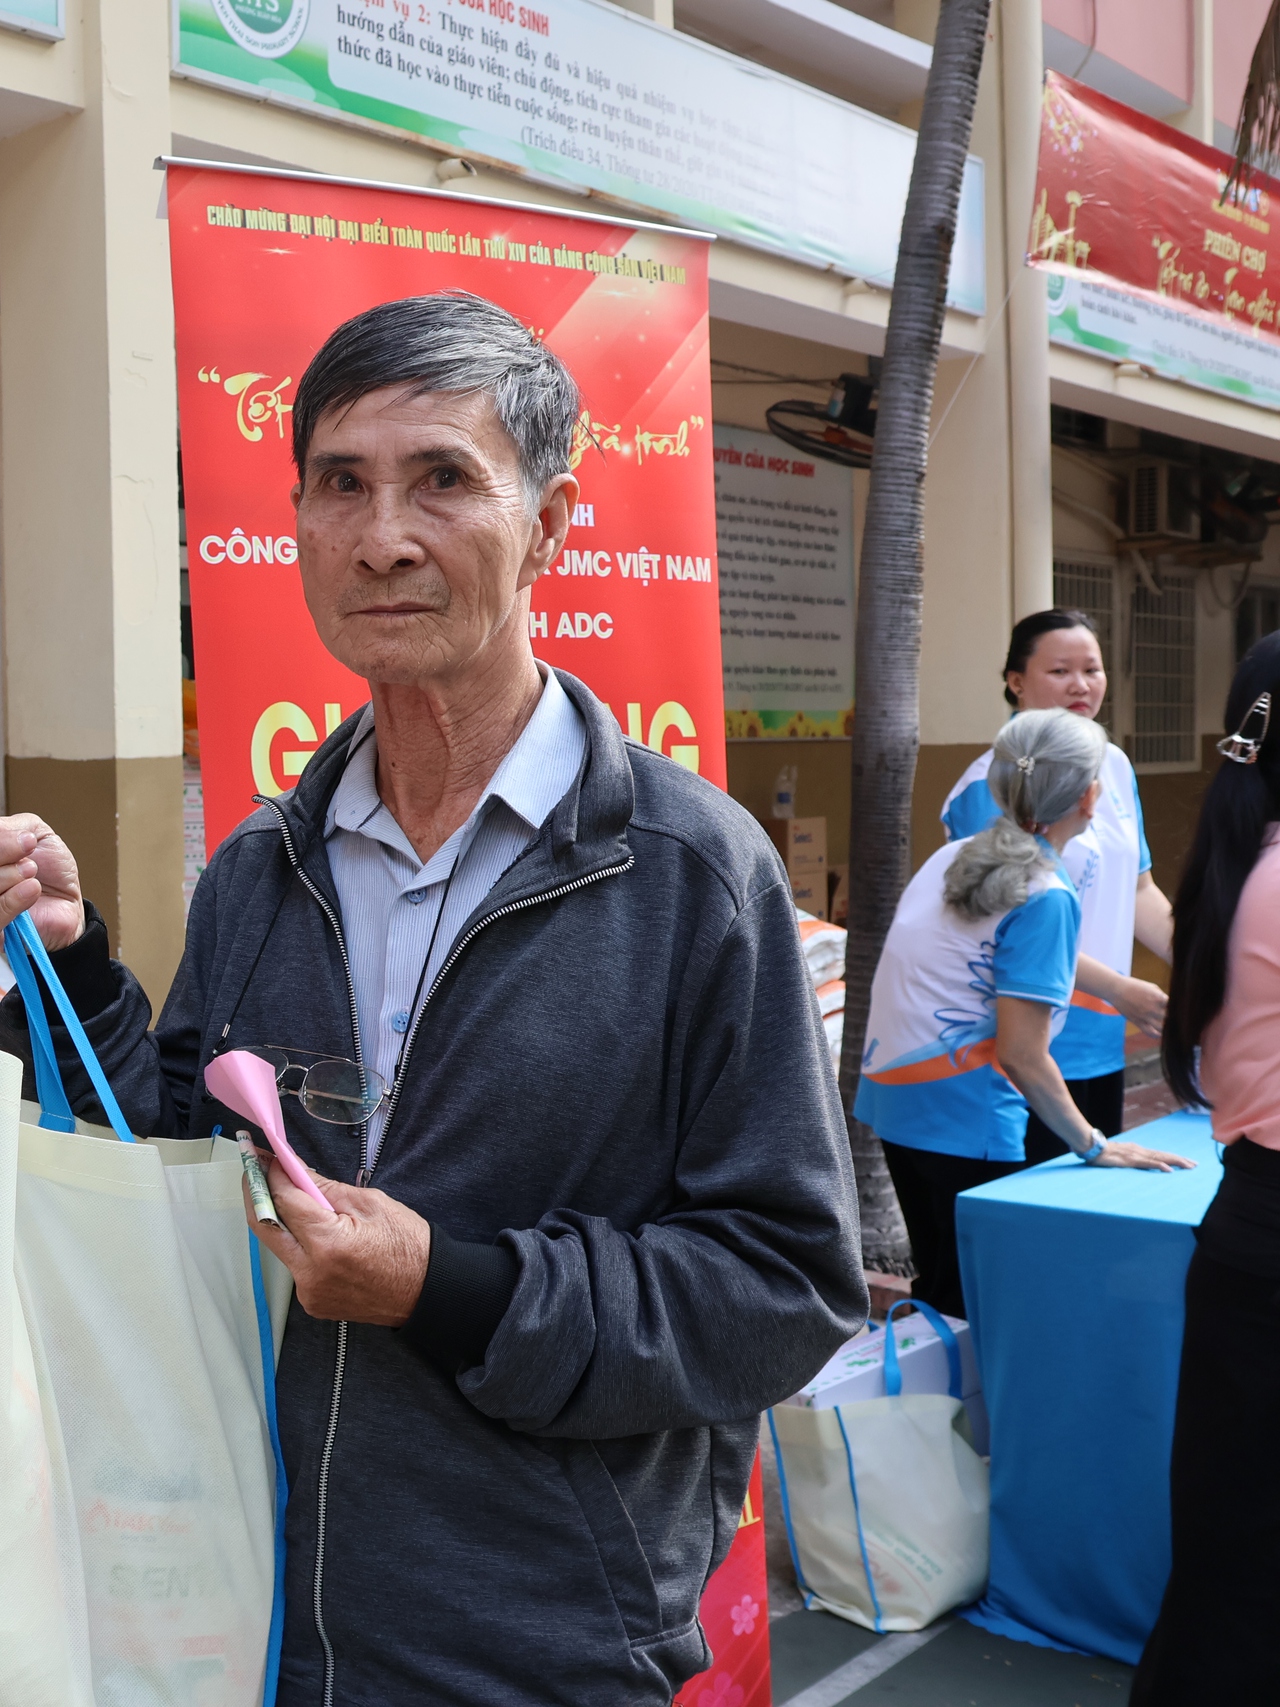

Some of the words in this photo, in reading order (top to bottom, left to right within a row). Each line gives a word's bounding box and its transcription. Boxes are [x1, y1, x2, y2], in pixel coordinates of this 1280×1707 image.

[337, 4, 384, 42] hướng
[389, 20, 415, 48] dẫn
[420, 34, 443, 59] của
[448, 44, 474, 69] giáo
[479, 56, 510, 82] viên;
[439, 11, 474, 41] Thực
[481, 27, 508, 53] hiện
[515, 39, 538, 69] đầy
[545, 51, 560, 71] đủ
[520, 6, 549, 37] SINH
[337, 34, 370, 62] thức
[375, 45, 393, 68] đã
[398, 56, 422, 79] học
[425, 66, 449, 88] vào
[454, 72, 484, 99] thực
[521, 123, 557, 156] (Trích
[206, 203, 242, 228] CHÀO
[245, 207, 287, 232] MỪNG
[290, 213, 311, 239] ĐẠI
[314, 215, 336, 242] HỘI
[339, 220, 359, 245] ĐẠI
[362, 218, 389, 245] BIỂU
[392, 225, 423, 249] TOÀN
[426, 229, 456, 253] QUỐC
[459, 232, 481, 257] LẦN
[484, 238, 505, 260] THỨ
[508, 243, 526, 262] XIV
[529, 240, 550, 266] CỦA
[553, 243, 583, 270] ĐẢNG
[585, 250, 616, 276] CỘNG
[664, 266, 686, 285] NAM
[713, 442, 742, 467] UYỀN
[199, 527, 298, 566] CÔNG
[556, 549, 611, 579] JMC
[616, 545, 660, 587] VIỆT
[666, 556, 712, 584] NAM
[555, 611, 614, 639] ADC
